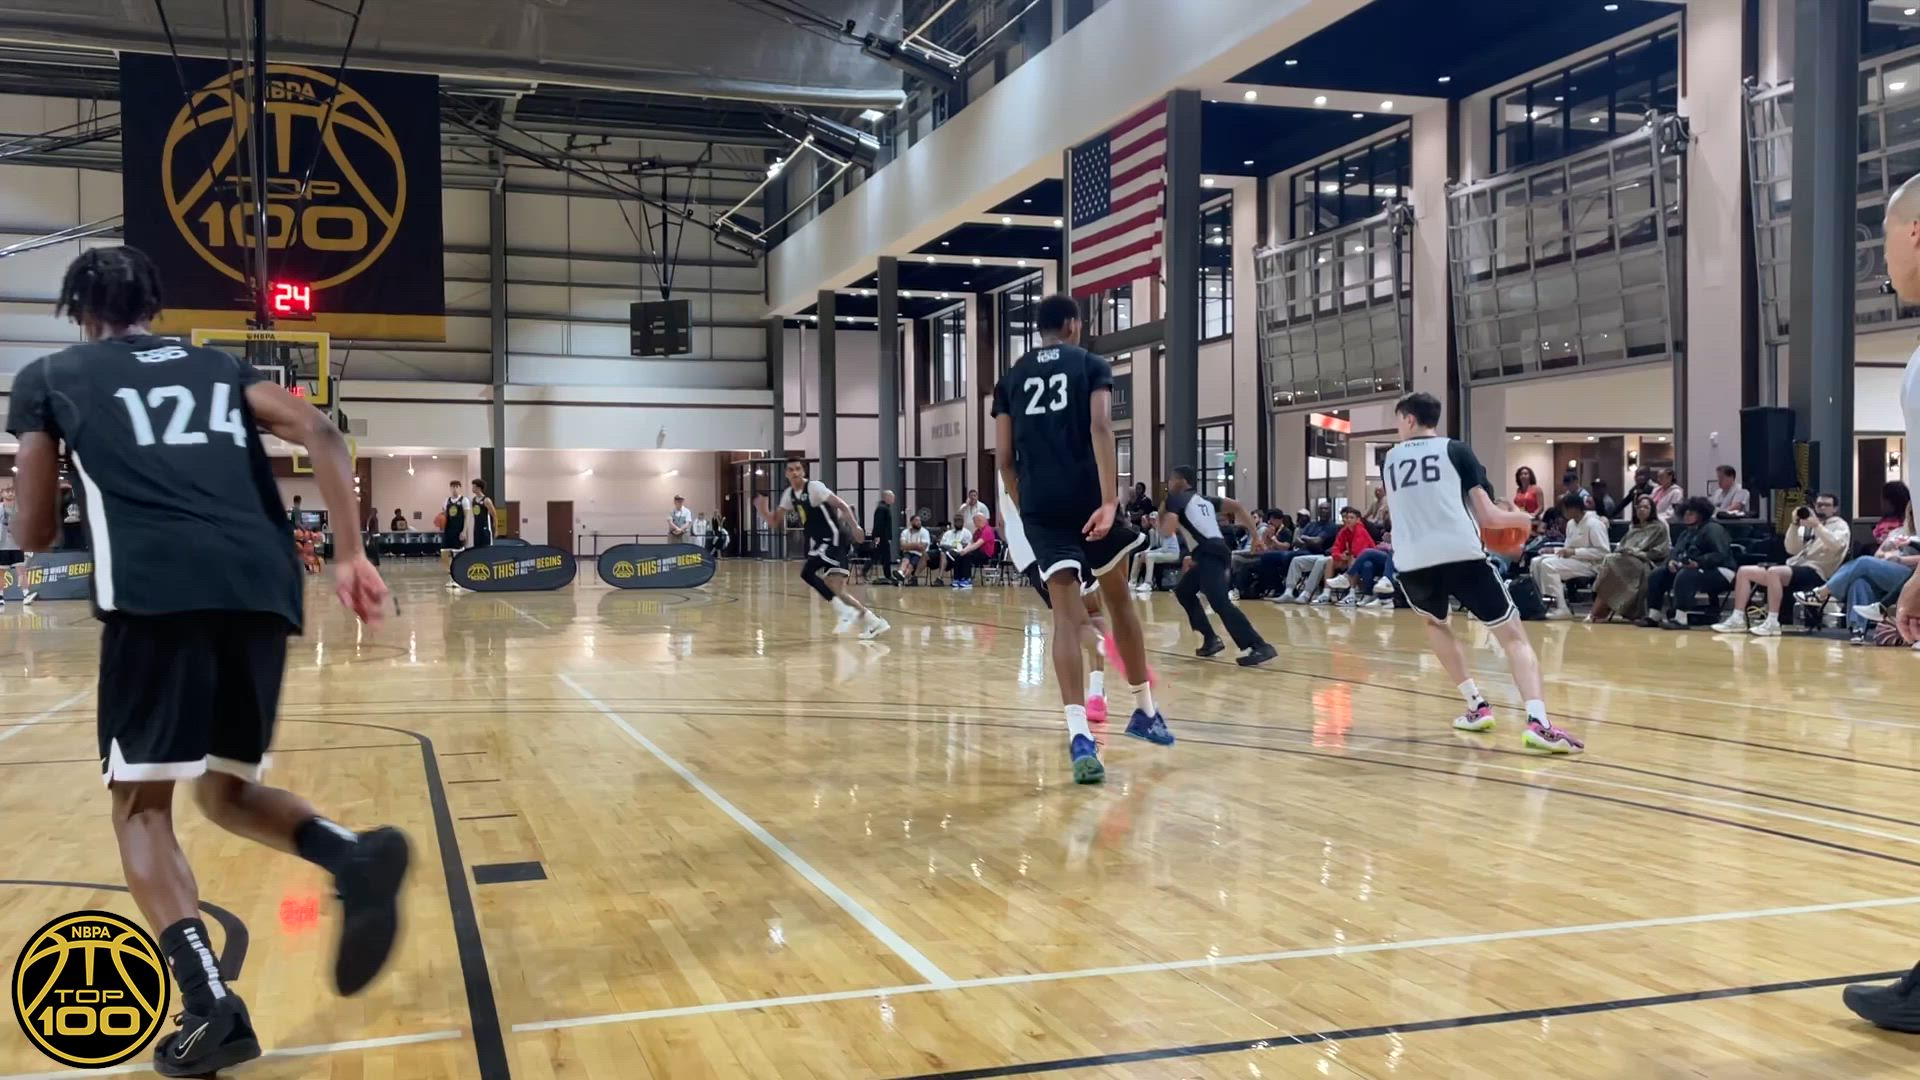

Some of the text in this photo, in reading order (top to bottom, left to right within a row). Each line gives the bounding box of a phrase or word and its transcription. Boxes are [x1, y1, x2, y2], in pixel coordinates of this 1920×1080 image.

[198, 200, 369, 251] 100
[274, 283, 310, 311] 24
[1024, 373, 1068, 415] 23
[113, 382, 248, 448] 124
[1388, 455, 1441, 492] 126
[492, 562, 515, 580] THIS
[536, 555, 562, 569] BEGINS
[636, 560, 657, 577] THIS
